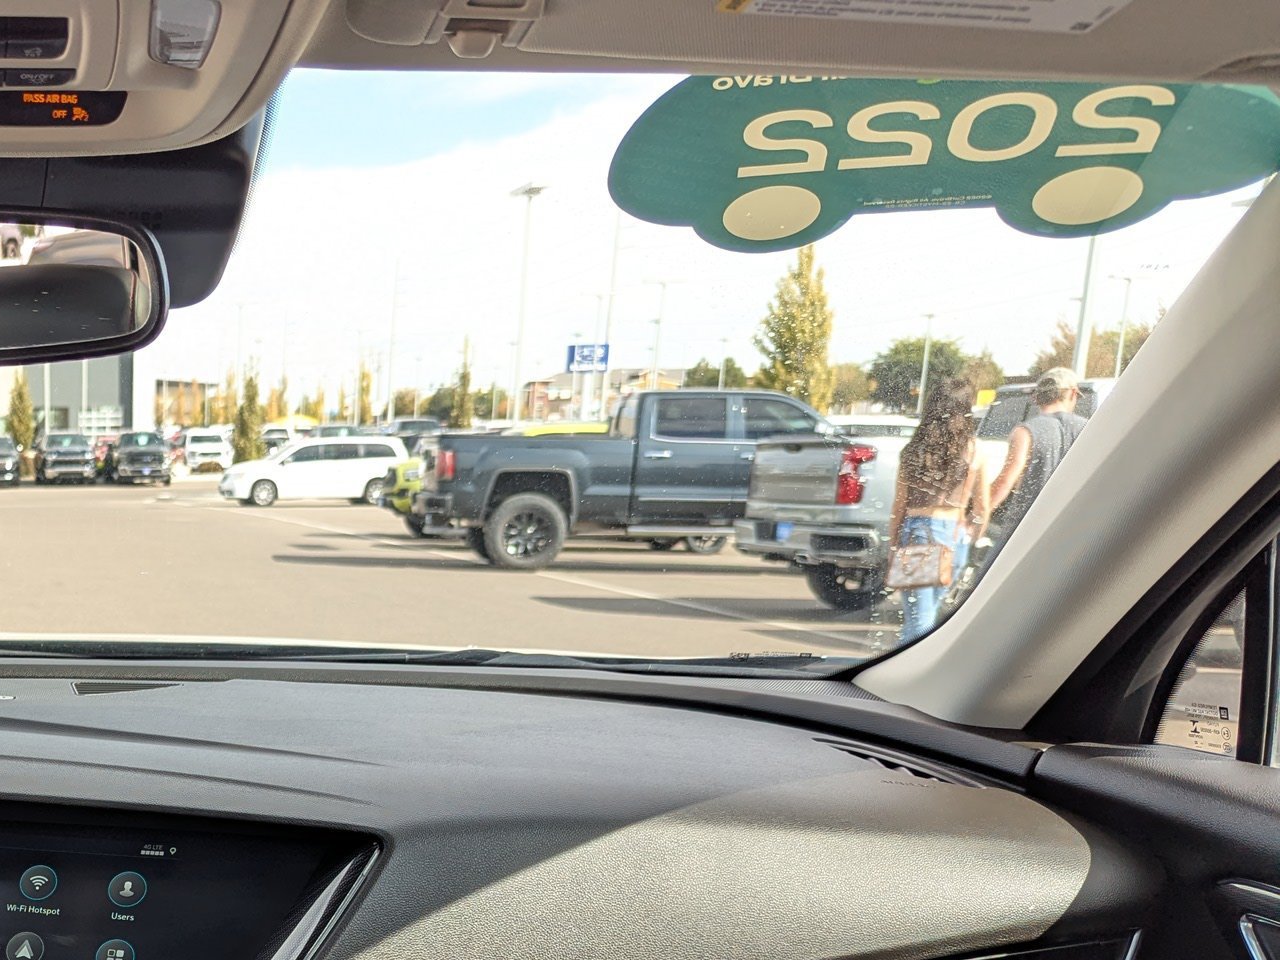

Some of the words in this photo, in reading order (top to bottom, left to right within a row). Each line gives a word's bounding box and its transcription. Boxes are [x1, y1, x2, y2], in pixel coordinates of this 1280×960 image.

[23, 93, 45, 103] PASS
[46, 94, 60, 103] AIR
[61, 94, 78, 104] BAG
[52, 110, 67, 119] OFF
[6, 903, 28, 913] Wi-Fi
[28, 905, 60, 916] Hotspot
[111, 912, 134, 921] Users
